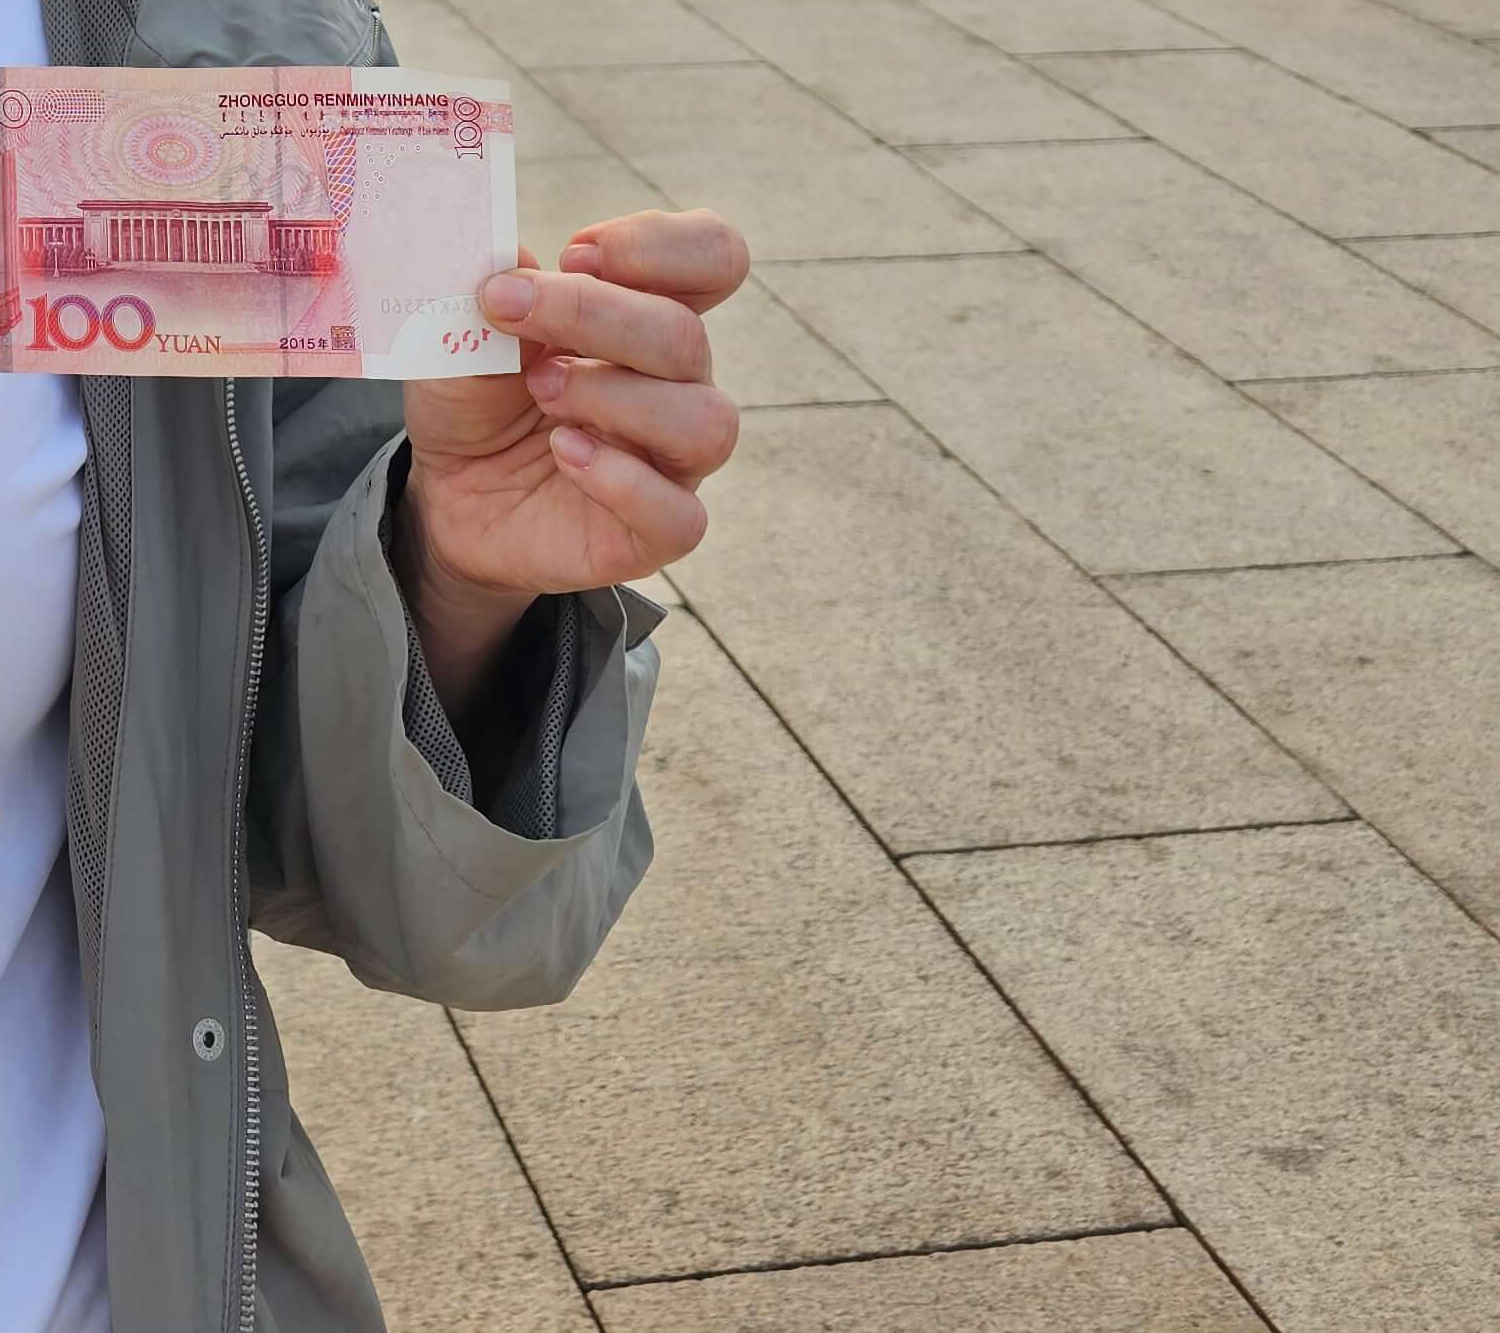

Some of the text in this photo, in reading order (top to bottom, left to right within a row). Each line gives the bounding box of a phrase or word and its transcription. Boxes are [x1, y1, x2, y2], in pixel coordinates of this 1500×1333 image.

[218, 93, 449, 108] ZHONGGUO RENMIN YINHANG
[453, 96, 483, 159] 100
[25, 292, 221, 354] 100 YUAN
[279, 337, 328, 350] 2015年
